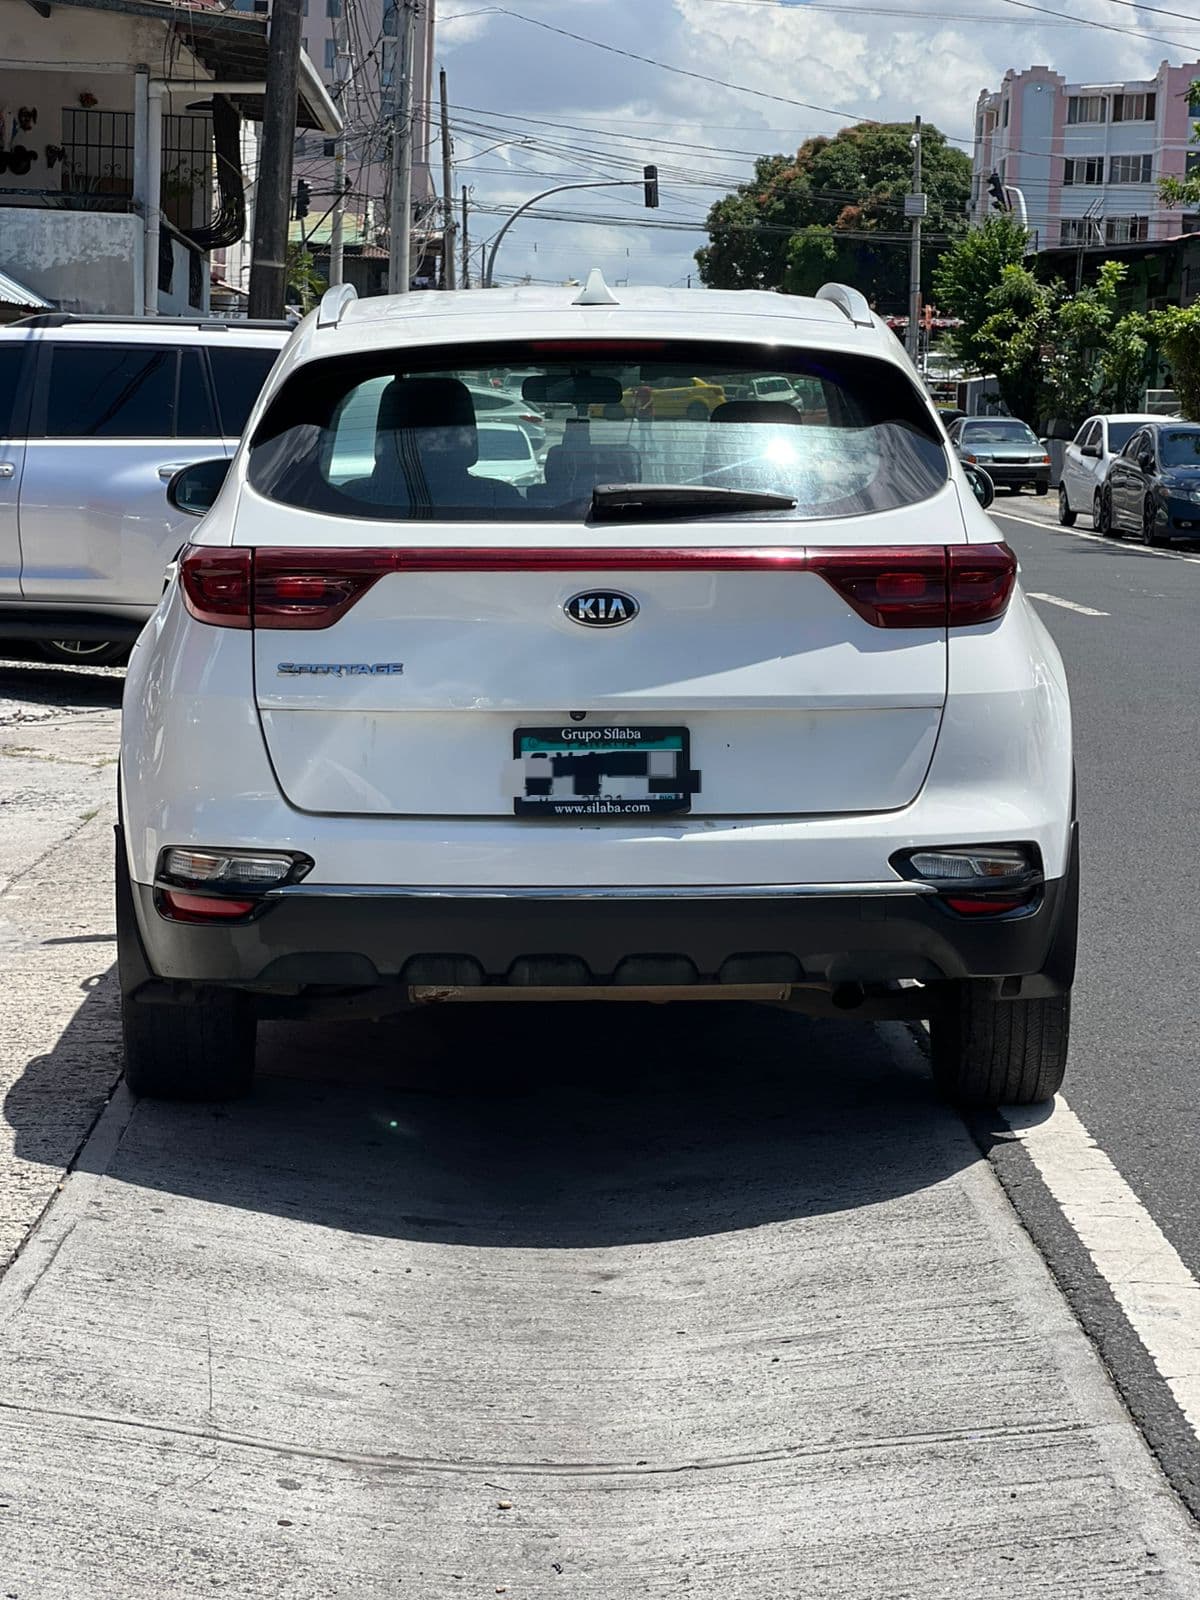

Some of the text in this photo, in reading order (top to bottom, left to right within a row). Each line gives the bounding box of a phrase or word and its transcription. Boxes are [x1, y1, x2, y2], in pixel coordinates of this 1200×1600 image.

[578, 598, 627, 619] KIA
[277, 662, 404, 676] SPORTAGE
[561, 728, 641, 742] Grupo Sílaba
[554, 801, 651, 813] www.silaba.com
